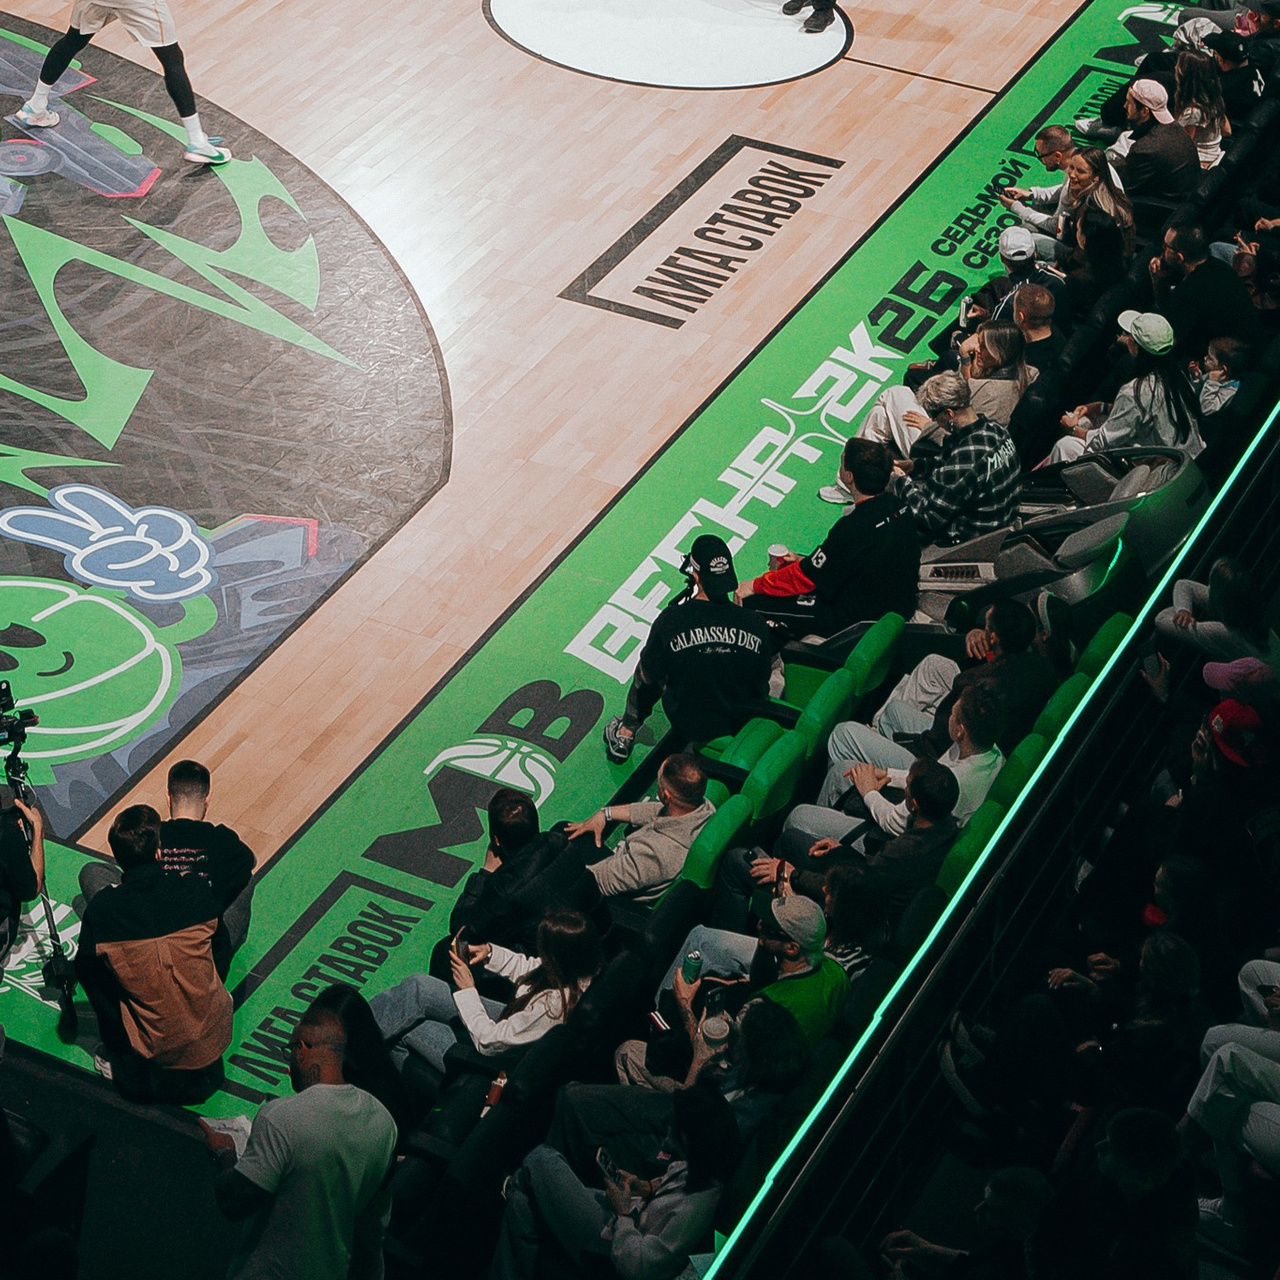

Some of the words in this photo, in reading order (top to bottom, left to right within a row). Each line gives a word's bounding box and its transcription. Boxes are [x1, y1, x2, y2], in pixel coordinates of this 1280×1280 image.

[632, 243, 749, 316] ЛИГА
[692, 158, 833, 253] СТАВОК
[930, 157, 1033, 258] СЕДЬМОЙ
[669, 626, 738, 654] CALABASSAS
